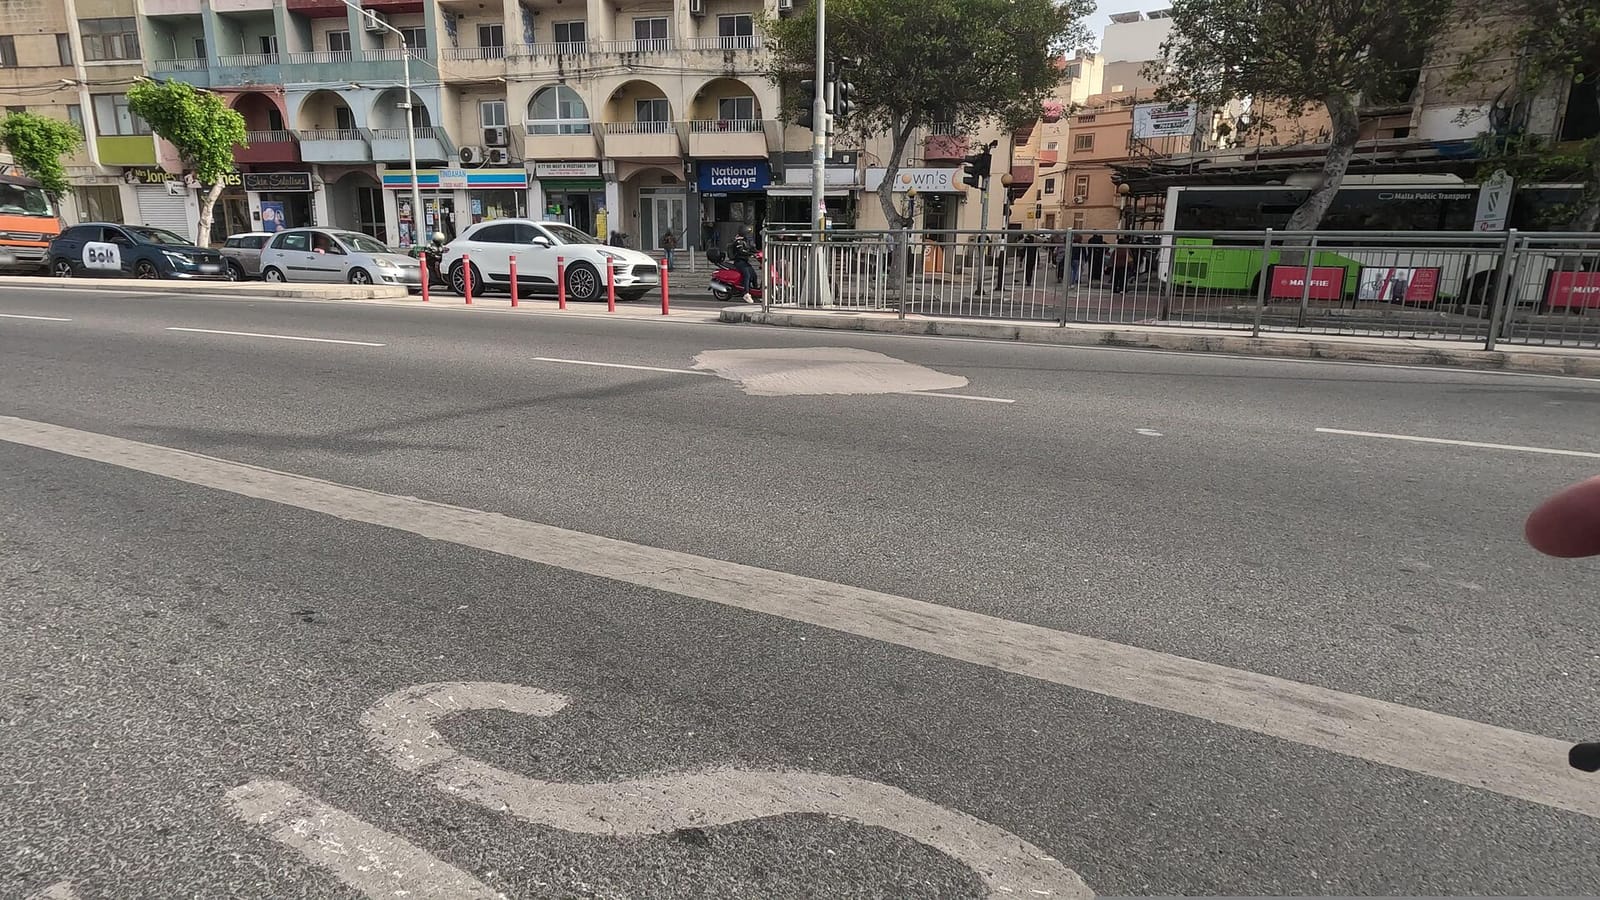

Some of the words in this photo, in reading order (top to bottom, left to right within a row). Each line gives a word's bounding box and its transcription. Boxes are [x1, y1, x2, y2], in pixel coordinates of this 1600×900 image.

[146, 169, 176, 182] Jones
[711, 166, 757, 176] National
[711, 177, 750, 189] Lottery
[896, 171, 947, 184] rown's
[1394, 192, 1414, 200] Malta
[1415, 192, 1437, 200] Public
[1438, 192, 1471, 201] Transport
[88, 248, 115, 264] Bolt
[1289, 279, 1329, 287] MAFRE
[1572, 286, 1600, 294] MAP
